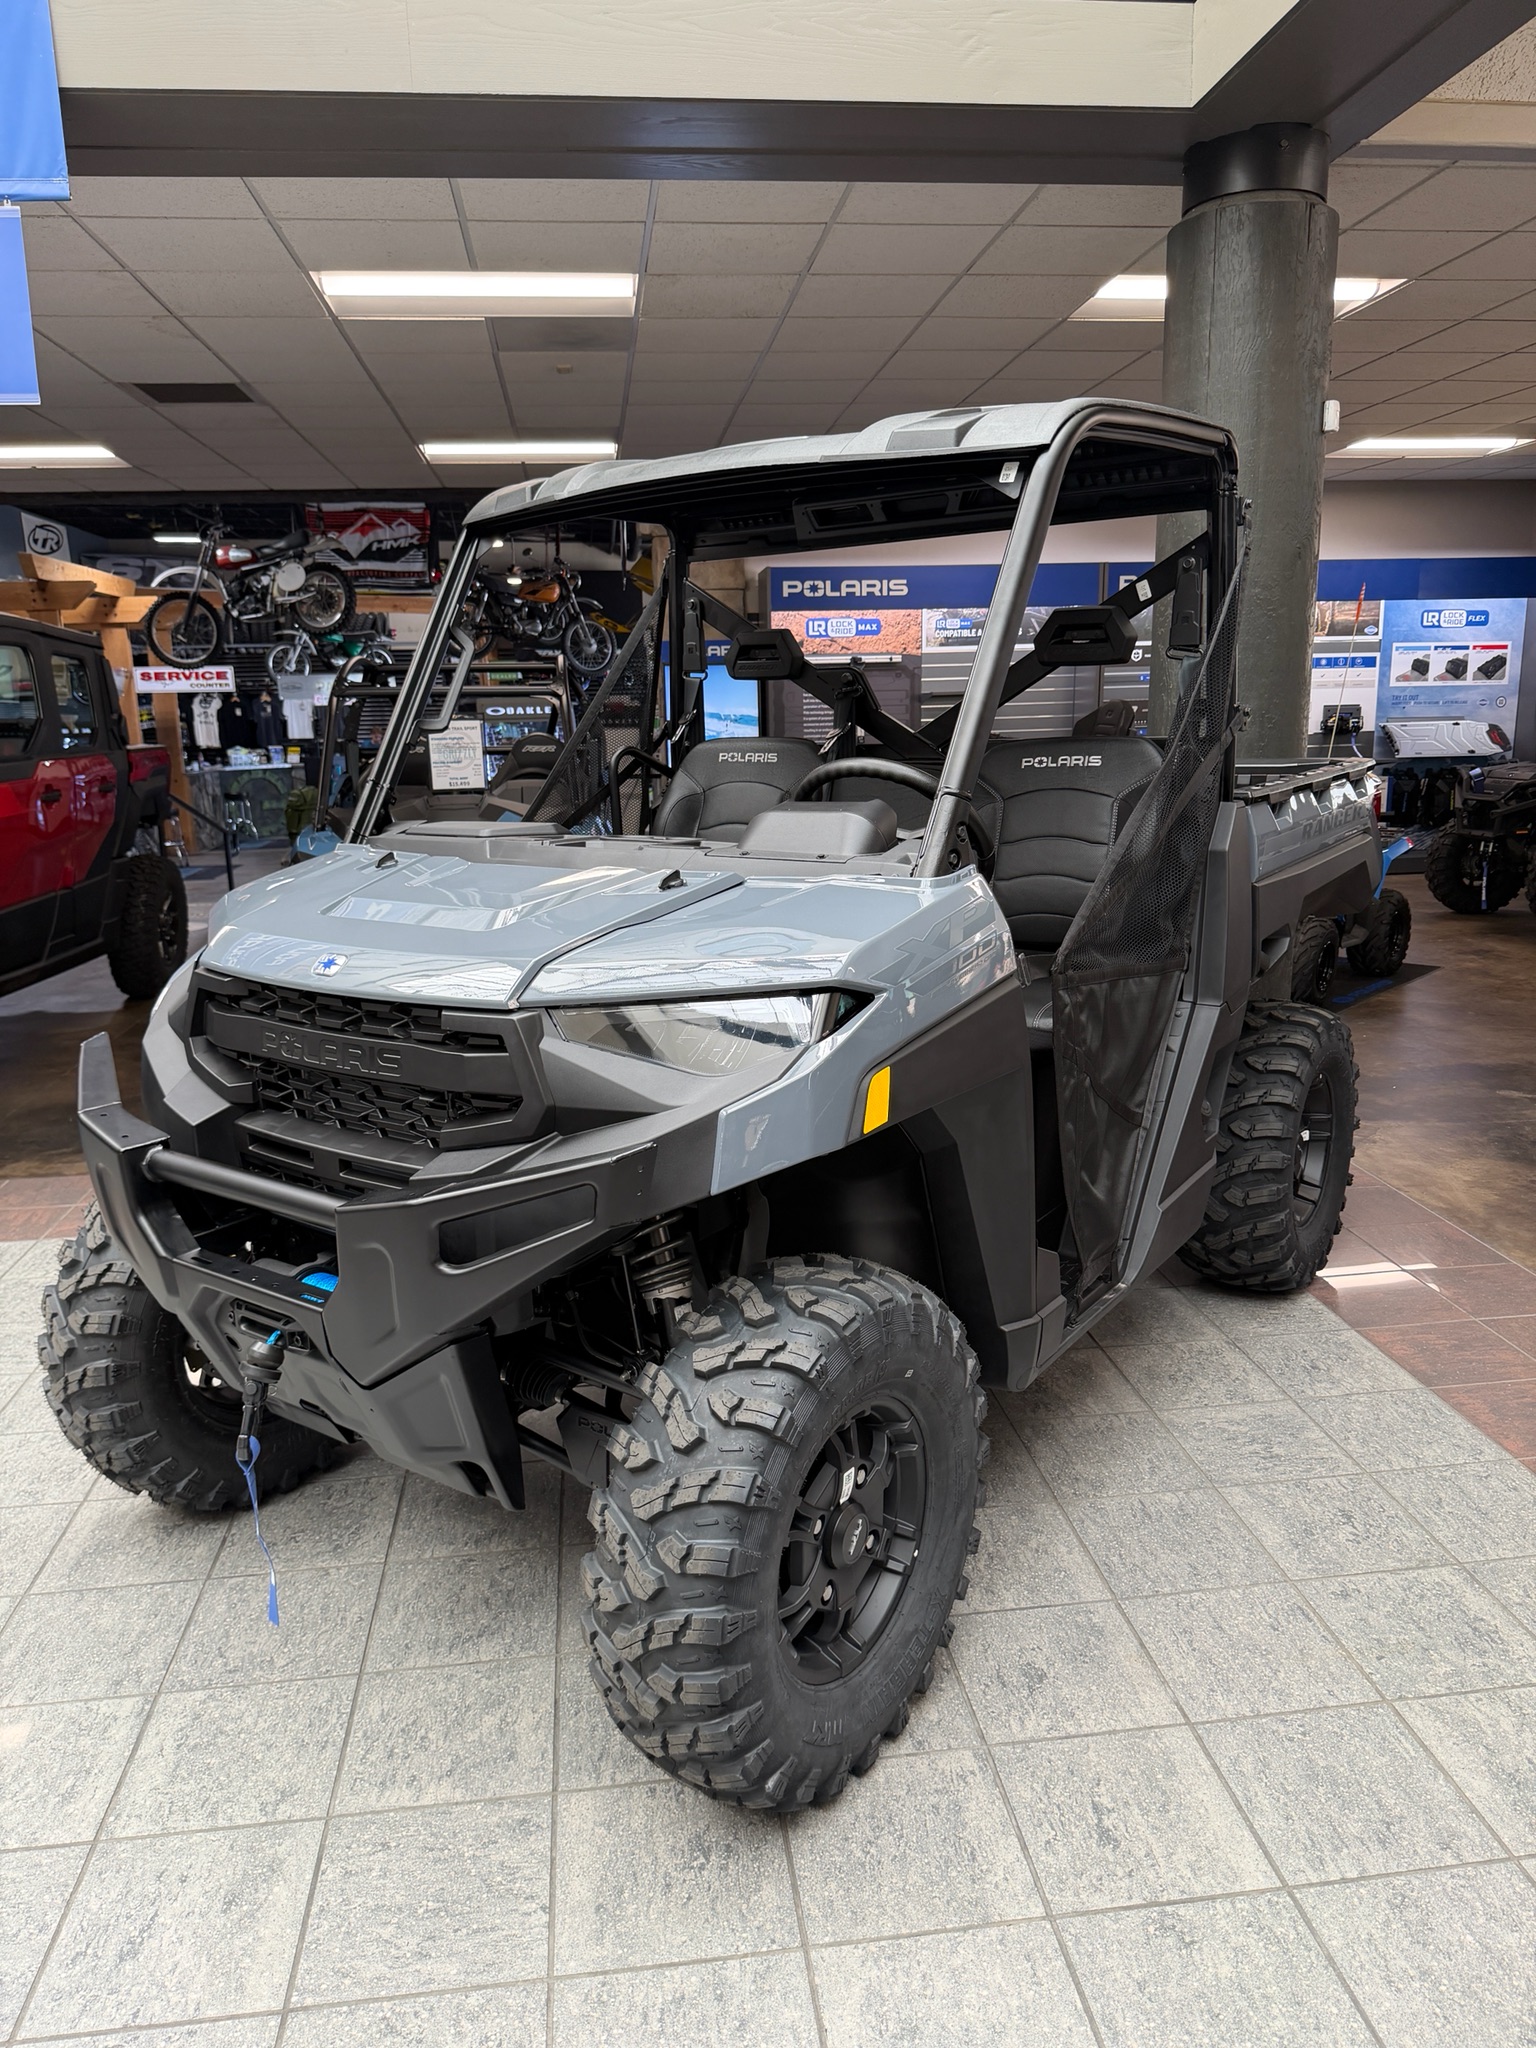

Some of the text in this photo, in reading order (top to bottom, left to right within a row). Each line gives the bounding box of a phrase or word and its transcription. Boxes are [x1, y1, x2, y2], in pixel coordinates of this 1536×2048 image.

[371, 535, 421, 551] HMK
[782, 579, 909, 597] POLARIS
[1443, 611, 1465, 619] LOCK
[830, 619, 854, 627] LOCK
[858, 623, 878, 631] MAX
[935, 629, 976, 638] COMPATIBLE
[139, 670, 230, 682] SERVICE
[506, 705, 553, 715] OAKLE
[718, 752, 778, 763] POLARIS
[1020, 755, 1103, 769] POLARIS
[261, 1029, 401, 1077] POLARIS
